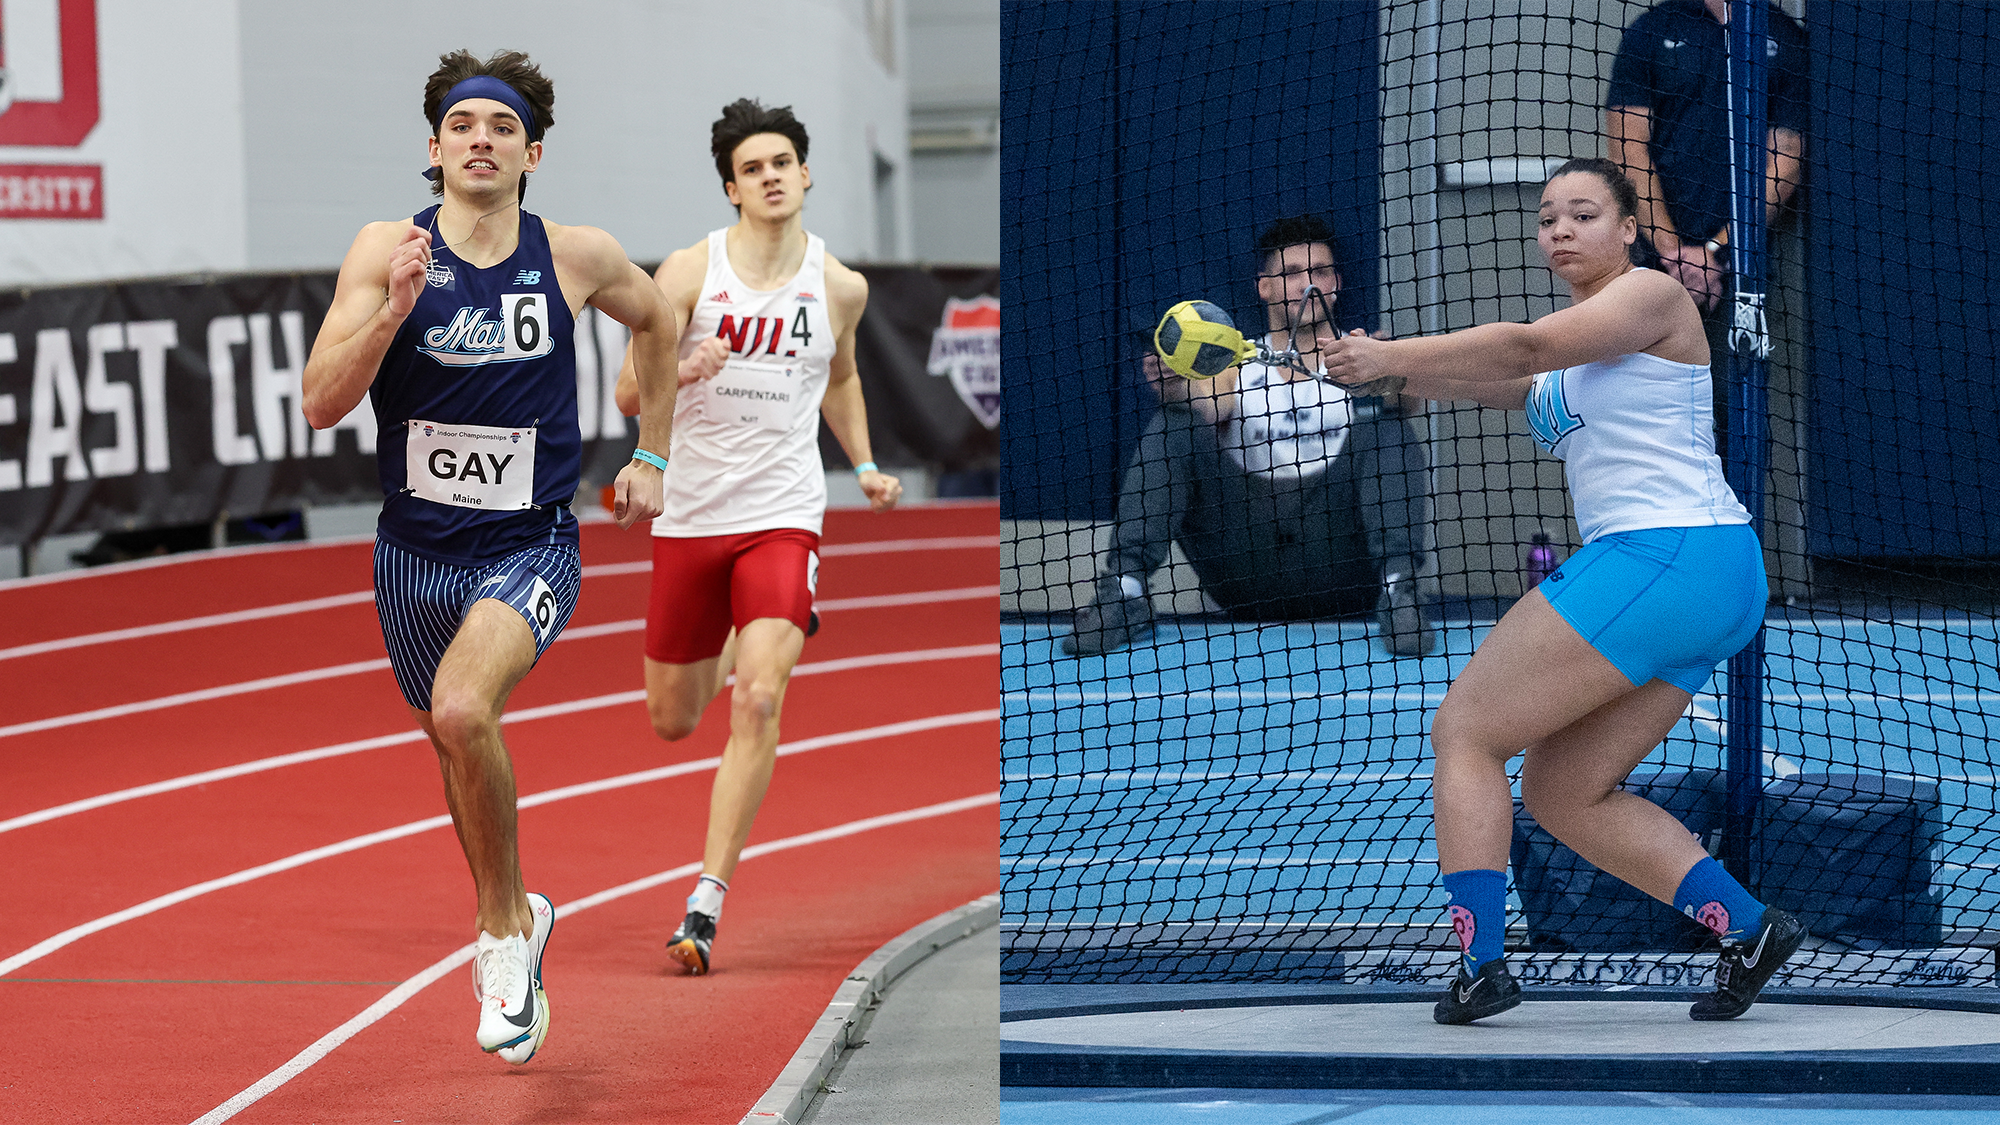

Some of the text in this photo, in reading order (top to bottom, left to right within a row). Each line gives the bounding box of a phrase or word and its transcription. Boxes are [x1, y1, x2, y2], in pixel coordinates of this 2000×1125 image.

[514, 296, 541, 352] 6
[716, 313, 797, 359] NJI
[791, 306, 812, 347] 4
[437, 430, 458, 438] Indoor
[459, 431, 507, 442] Championships
[428, 448, 515, 485] GAY
[452, 493, 482, 505] Maine
[536, 590, 555, 630] 6
